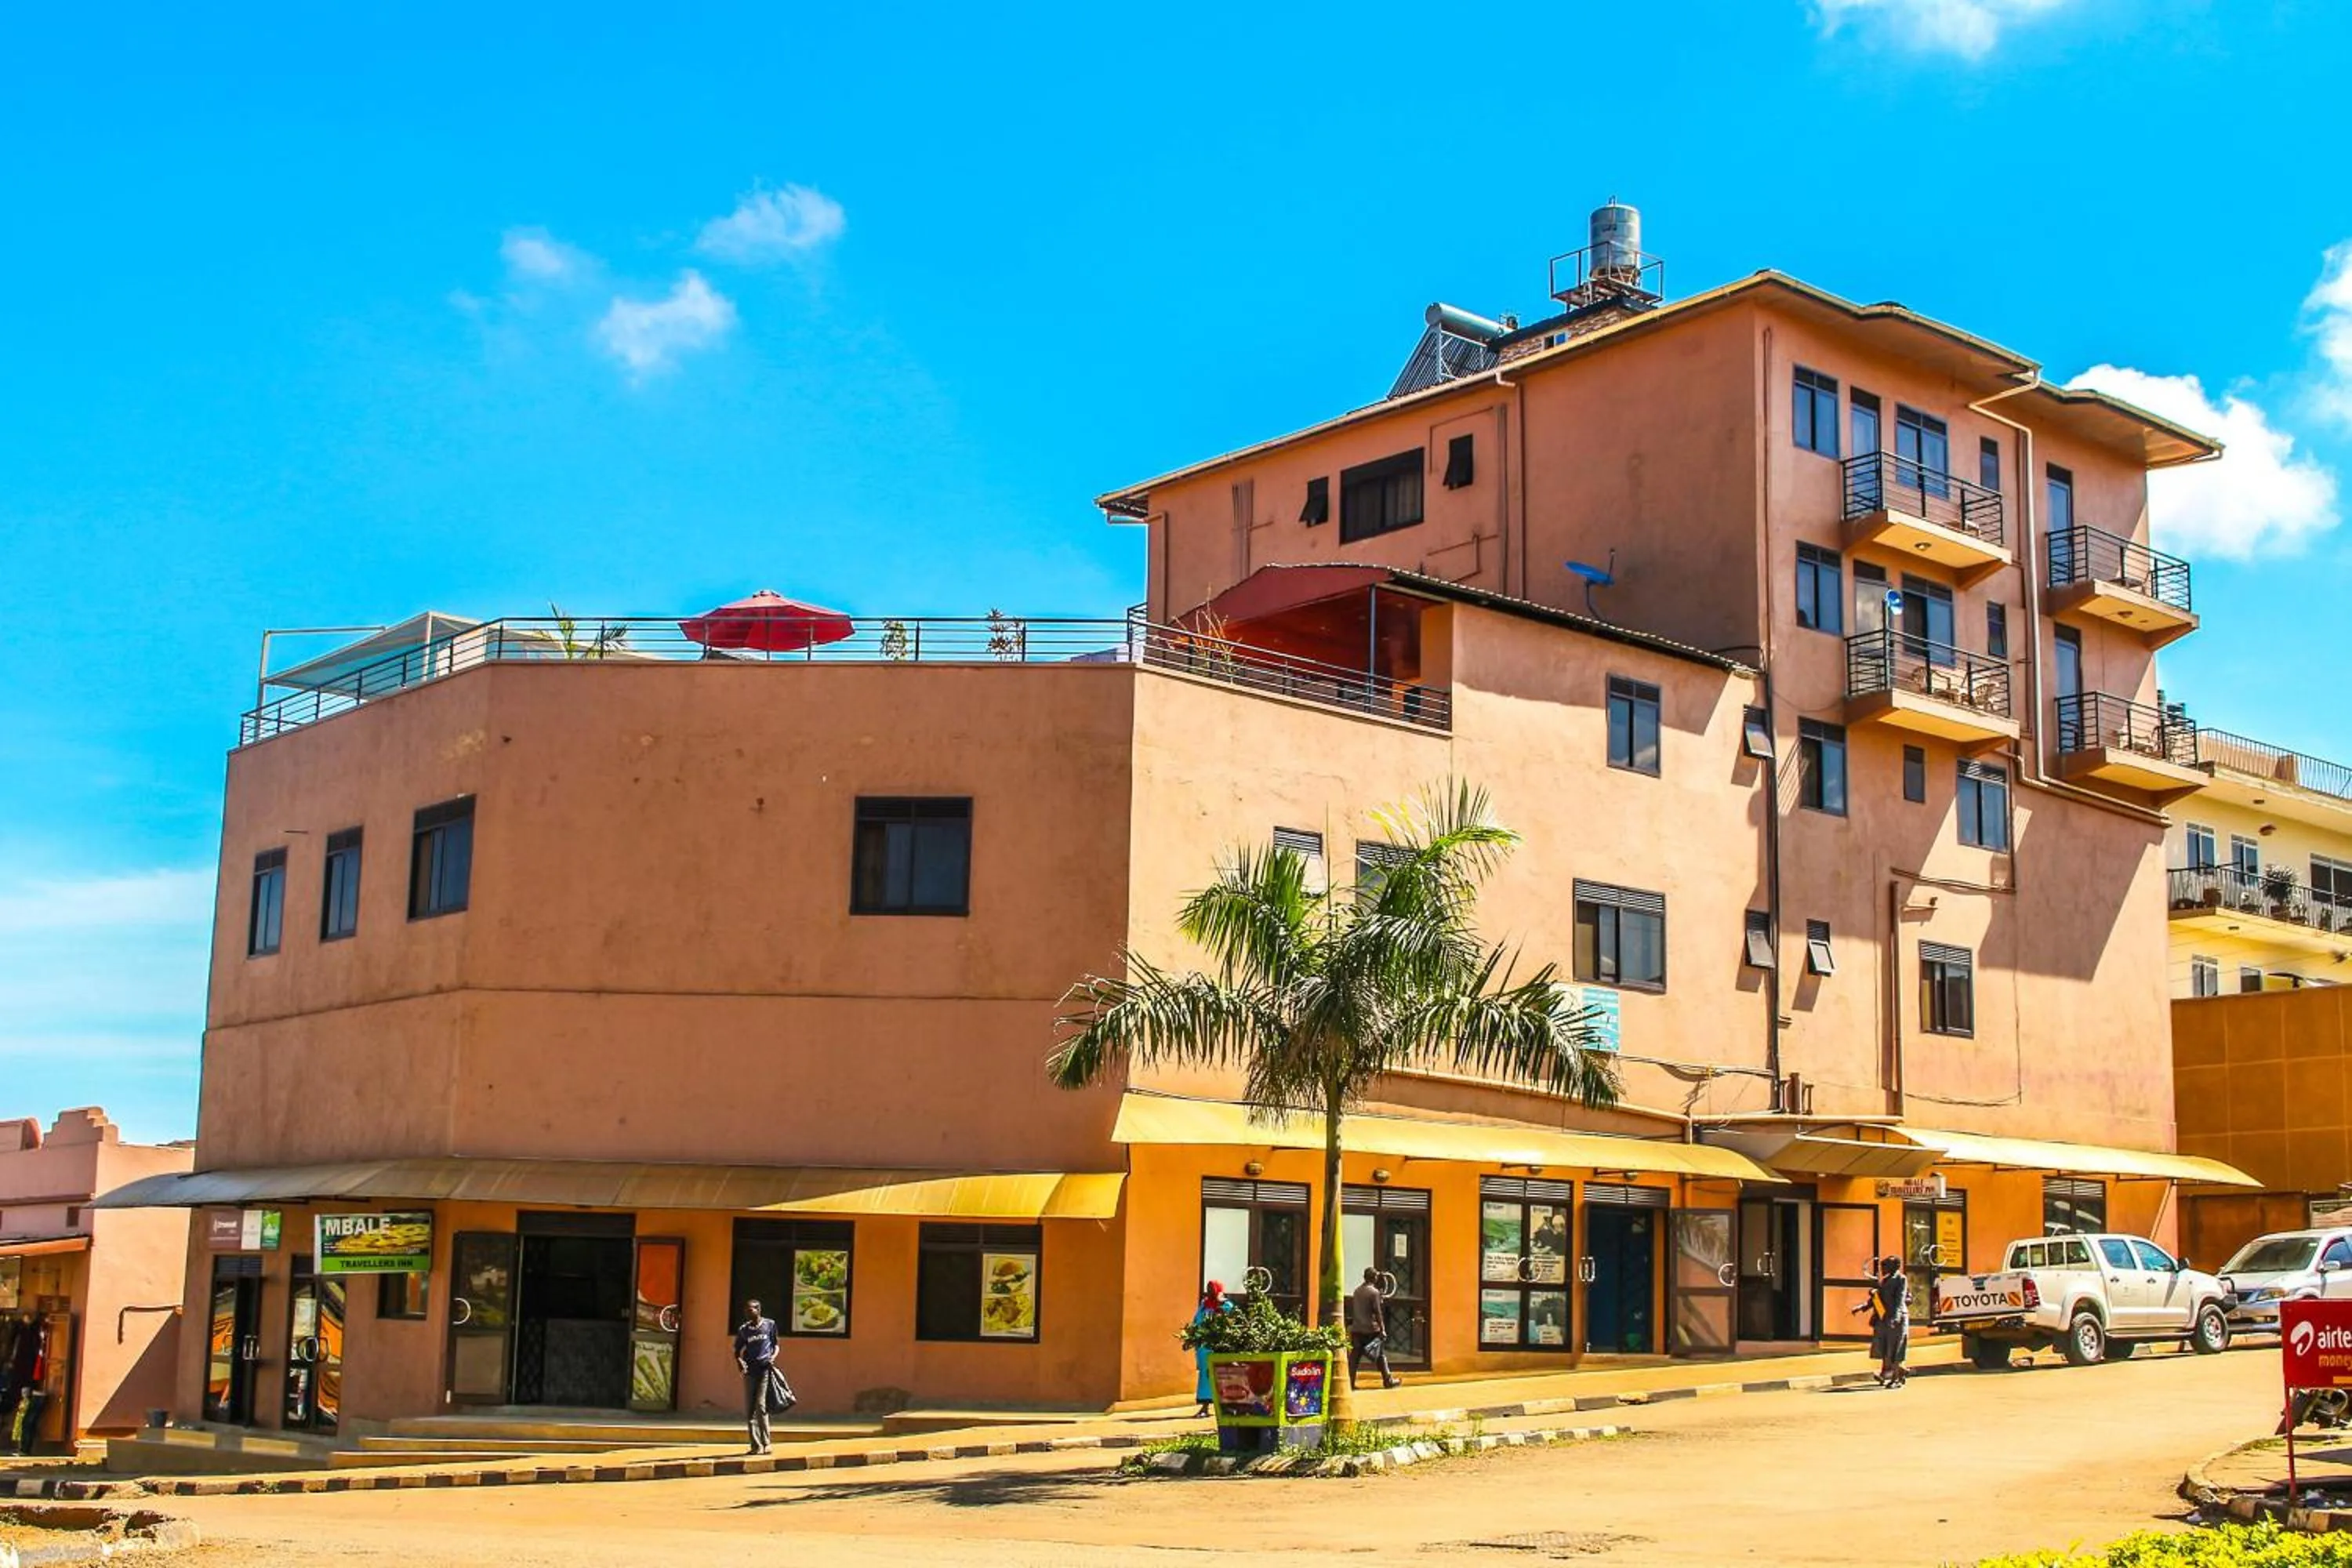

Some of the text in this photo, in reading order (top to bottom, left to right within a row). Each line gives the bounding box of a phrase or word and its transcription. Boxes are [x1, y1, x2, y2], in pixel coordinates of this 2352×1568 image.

[325, 1217, 391, 1236] MBALE
[1953, 1293, 2008, 1307] TOYOTA
[1291, 1367, 1321, 1376] Sadolin
